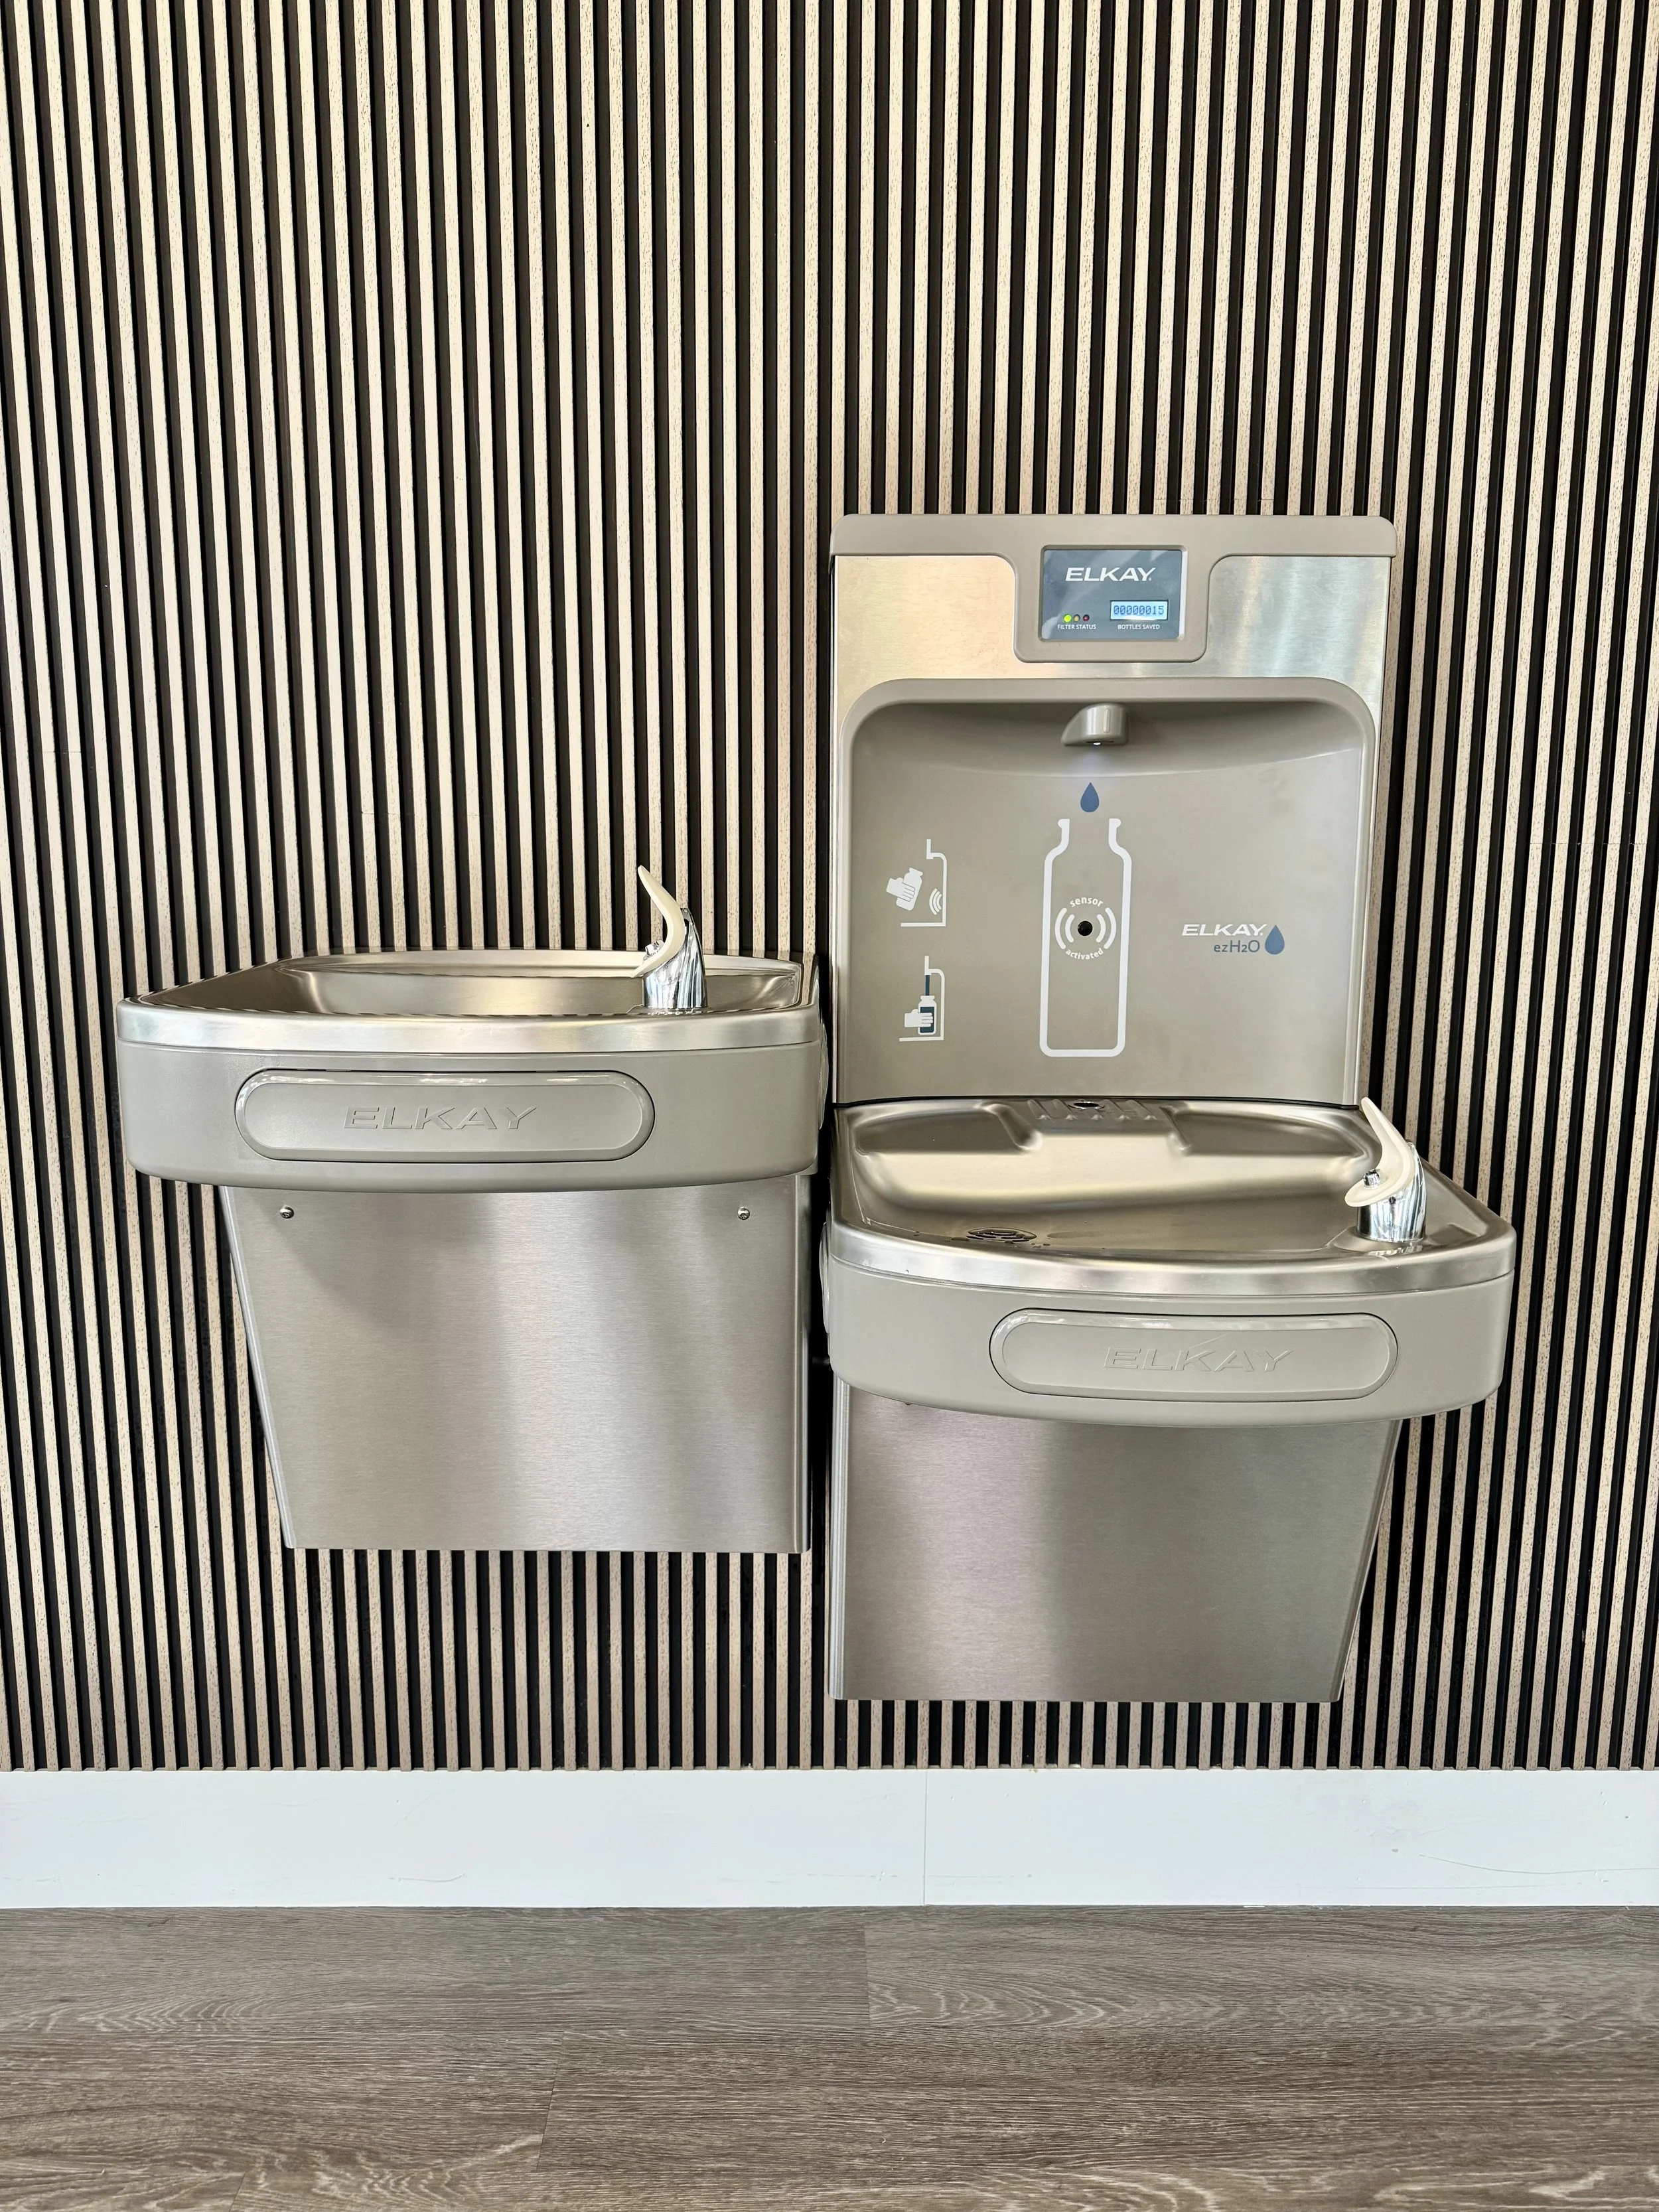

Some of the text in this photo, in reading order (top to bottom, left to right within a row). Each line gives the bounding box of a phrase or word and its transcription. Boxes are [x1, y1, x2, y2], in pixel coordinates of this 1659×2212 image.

[1070, 897, 1104, 907] sensor
[1066, 948, 1104, 960] activated
[344, 1107, 537, 1130] ELKAY
[1104, 1347, 1294, 1372] ELKAY
